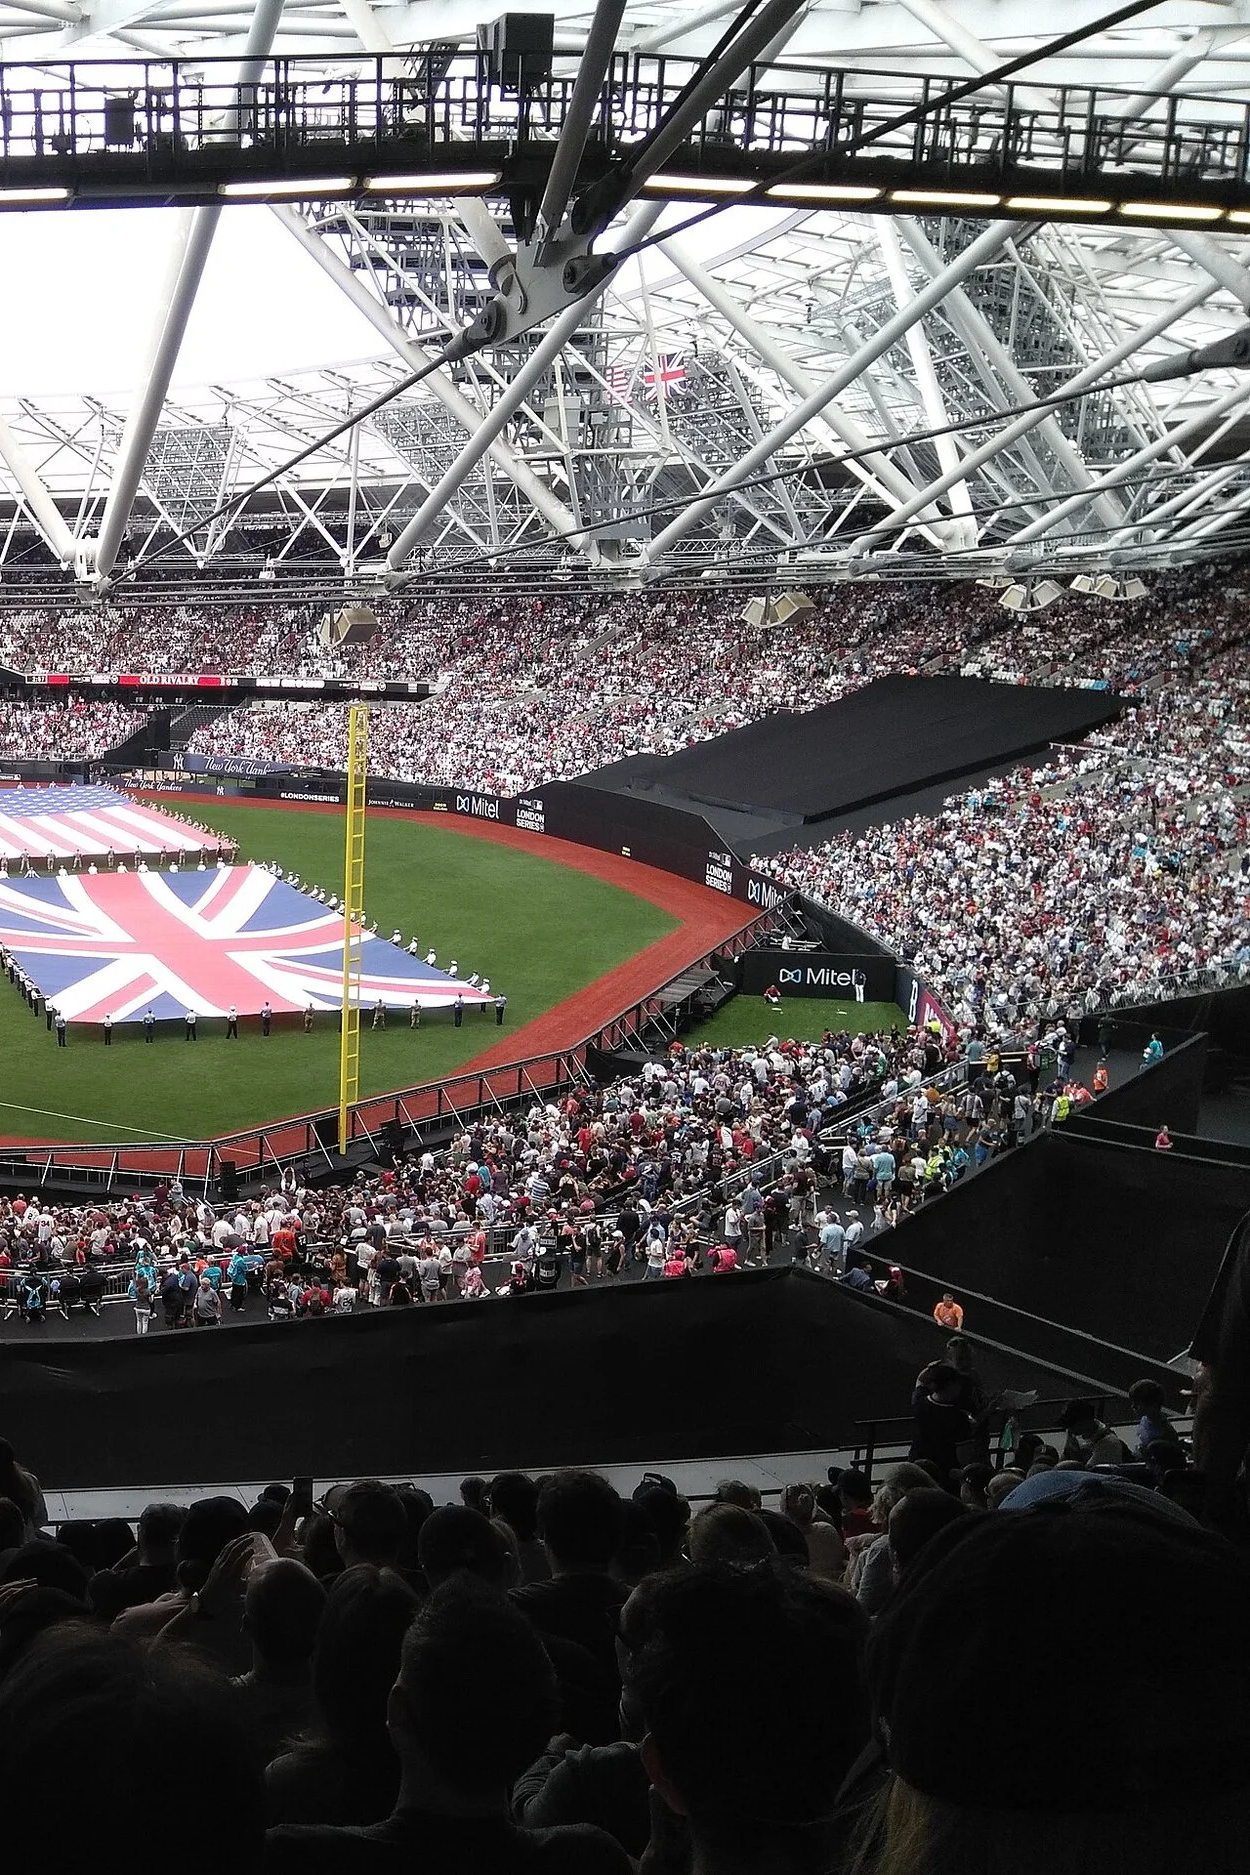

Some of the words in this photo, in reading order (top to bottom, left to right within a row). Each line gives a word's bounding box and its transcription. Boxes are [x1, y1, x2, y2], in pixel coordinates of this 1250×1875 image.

[139, 676, 161, 685] OLD
[161, 677, 199, 686] RIVALRY
[204, 756, 222, 770] New
[224, 758, 245, 774] York
[123, 778, 139, 788] New
[156, 781, 182, 792] Yankees
[280, 792, 340, 802] #LONDONSERIES
[471, 796, 499, 819] Mitel
[516, 808, 545, 823] LONDON
[516, 818, 540, 831] SERIES
[706, 863, 733, 882] LONDON
[705, 874, 728, 892] SERIES
[806, 968, 856, 985] Mitel
